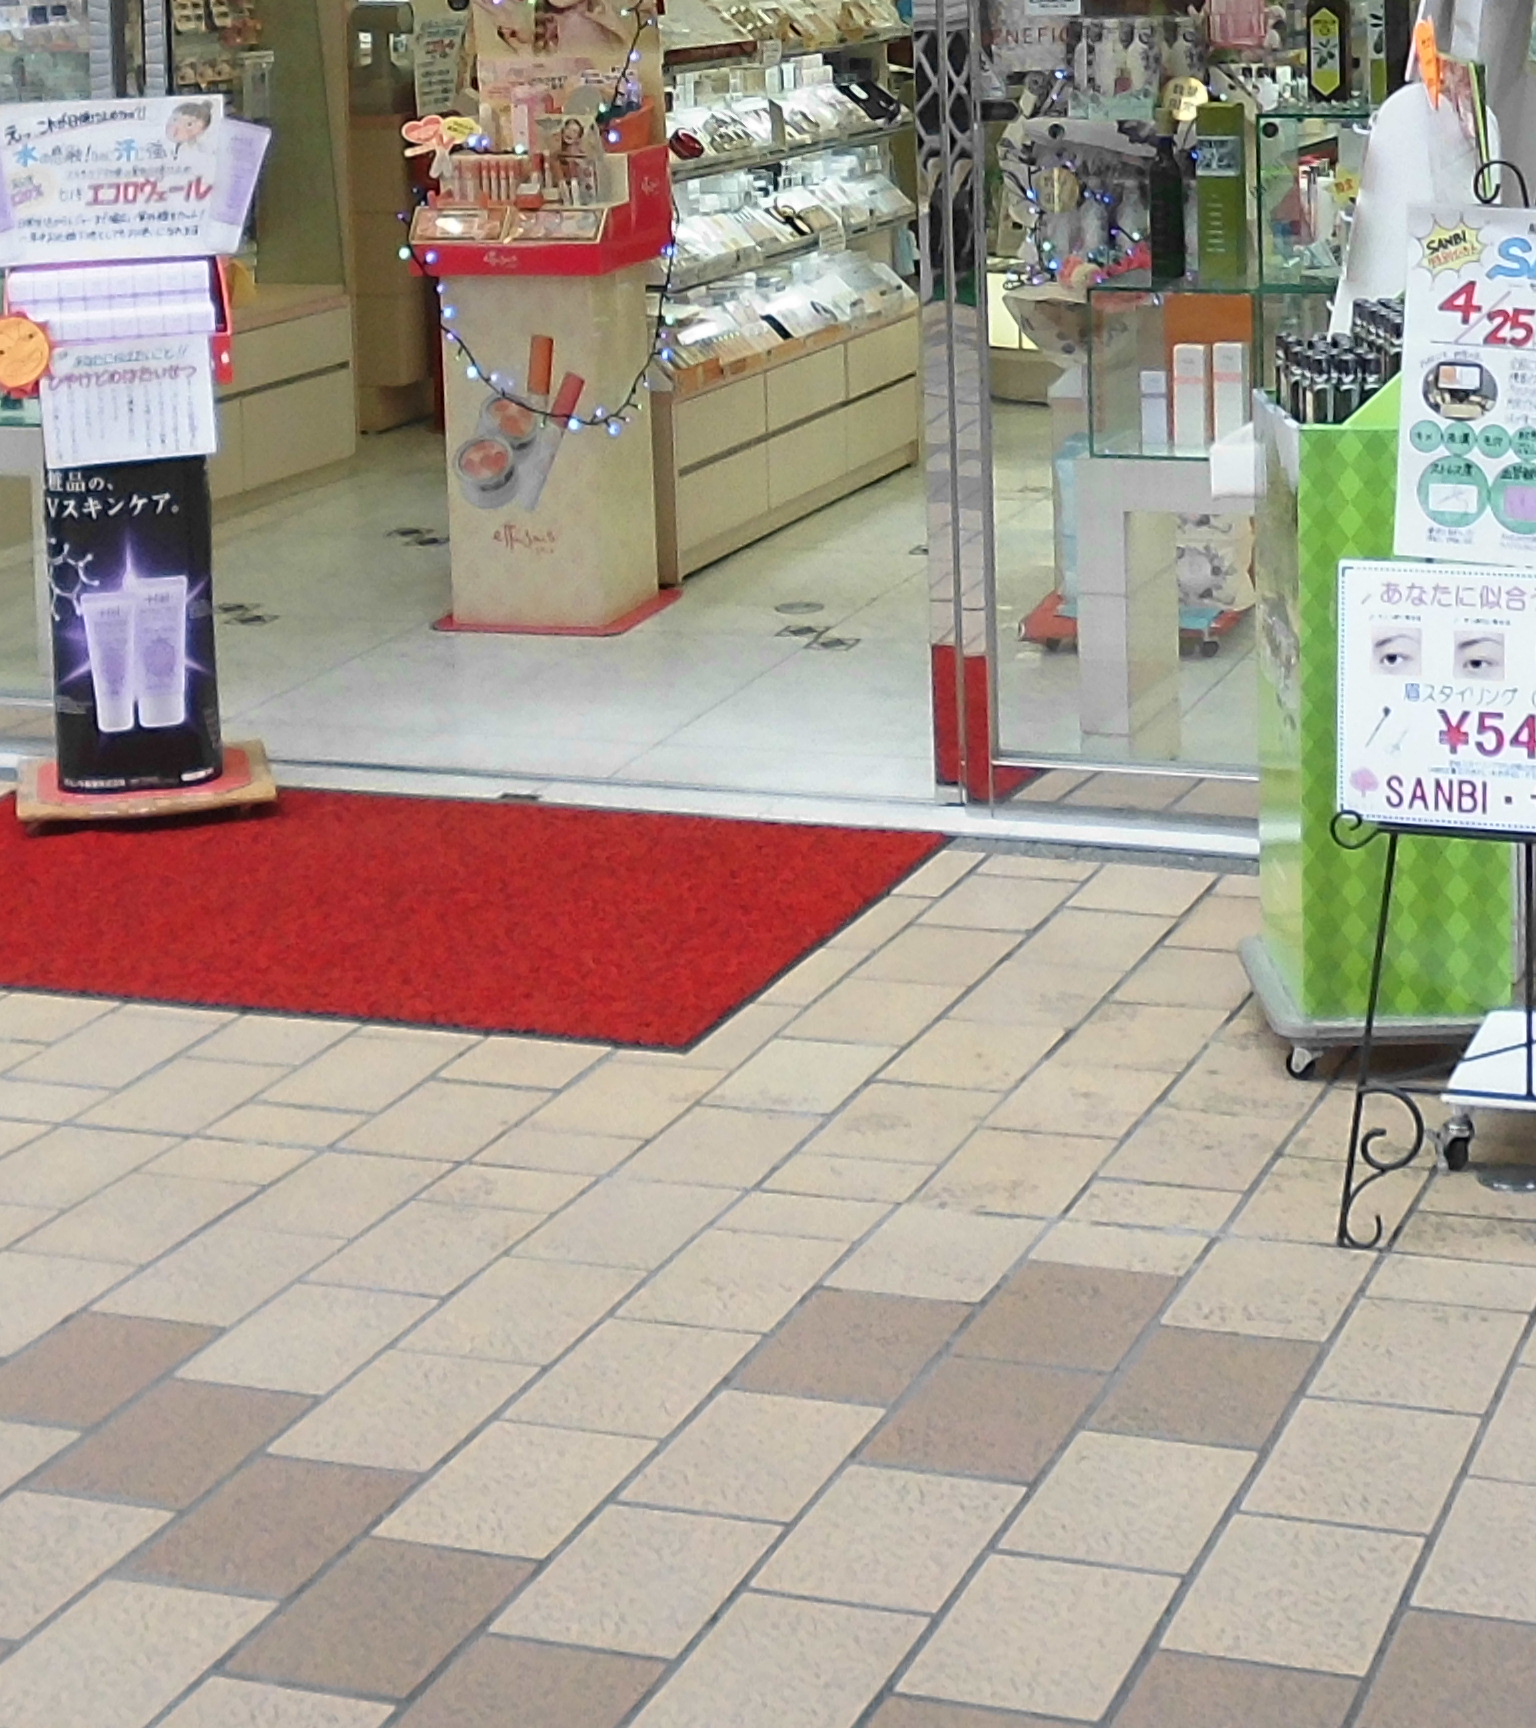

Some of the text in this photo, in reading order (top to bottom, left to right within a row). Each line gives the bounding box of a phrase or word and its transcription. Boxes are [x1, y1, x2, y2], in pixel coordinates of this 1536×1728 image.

[1426, 229, 1467, 255] SANBI
[46, 493, 181, 520] Vスキンケア。
